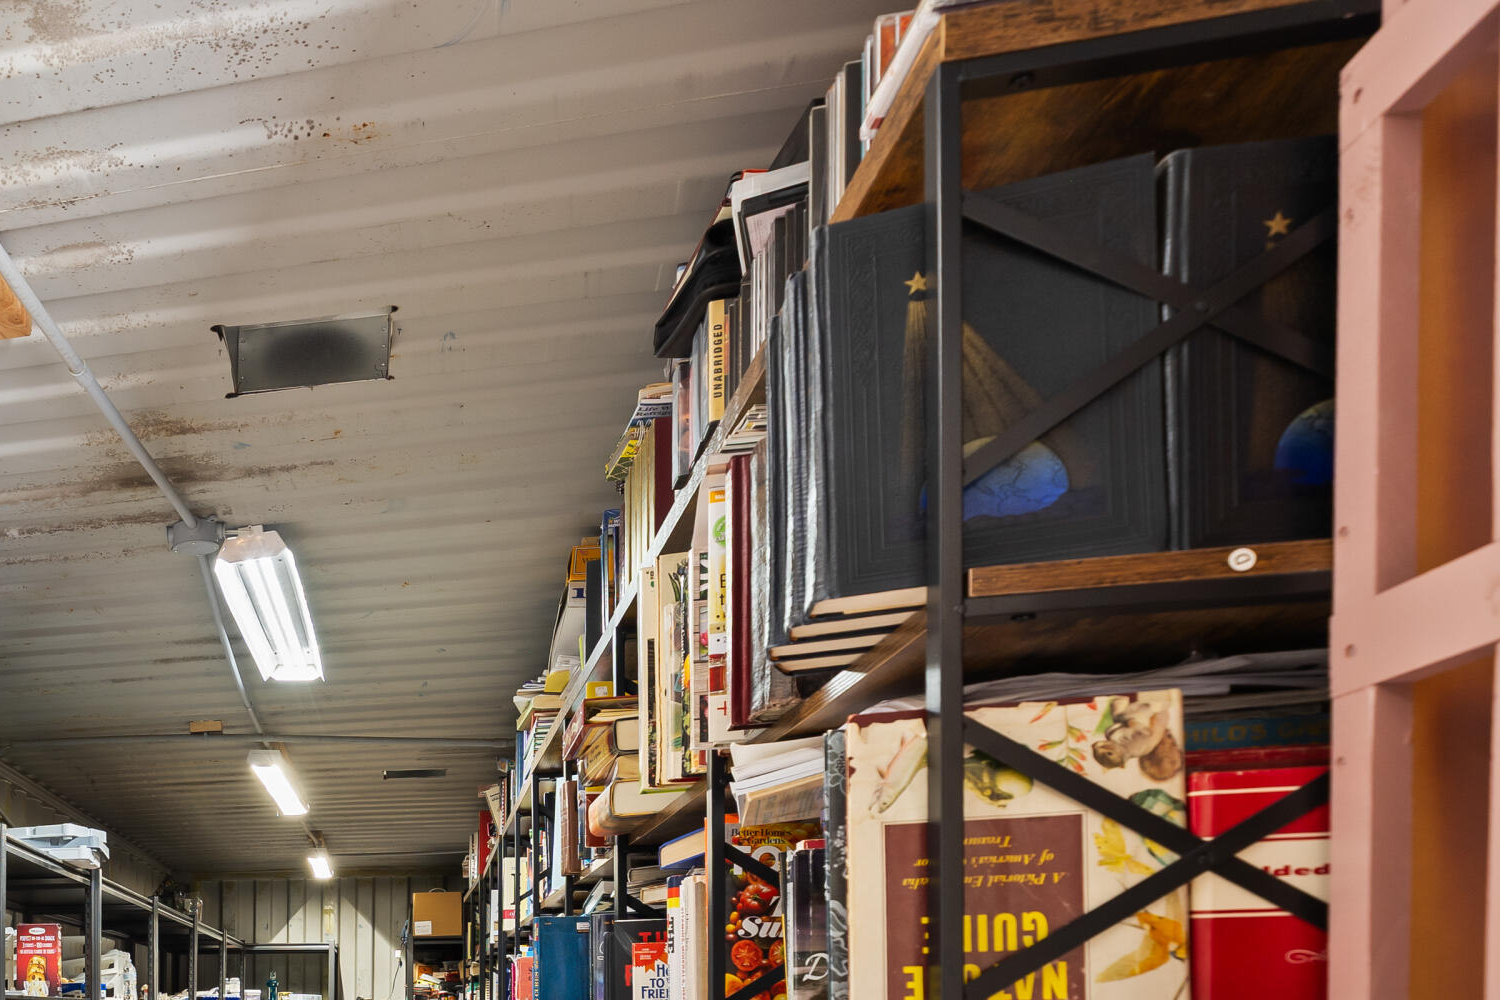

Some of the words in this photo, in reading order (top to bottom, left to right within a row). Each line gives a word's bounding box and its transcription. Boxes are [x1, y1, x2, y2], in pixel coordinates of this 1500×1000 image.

[713, 322, 723, 399] UNABRIDGED
[731, 828, 760, 837] Better
[761, 828, 792, 838] Homes
[972, 852, 1036, 868] America's
[1037, 849, 1055, 867] of
[988, 871, 1048, 888] Pictorial
[920, 911, 1049, 954] GUI
[650, 978, 665, 989] TO
